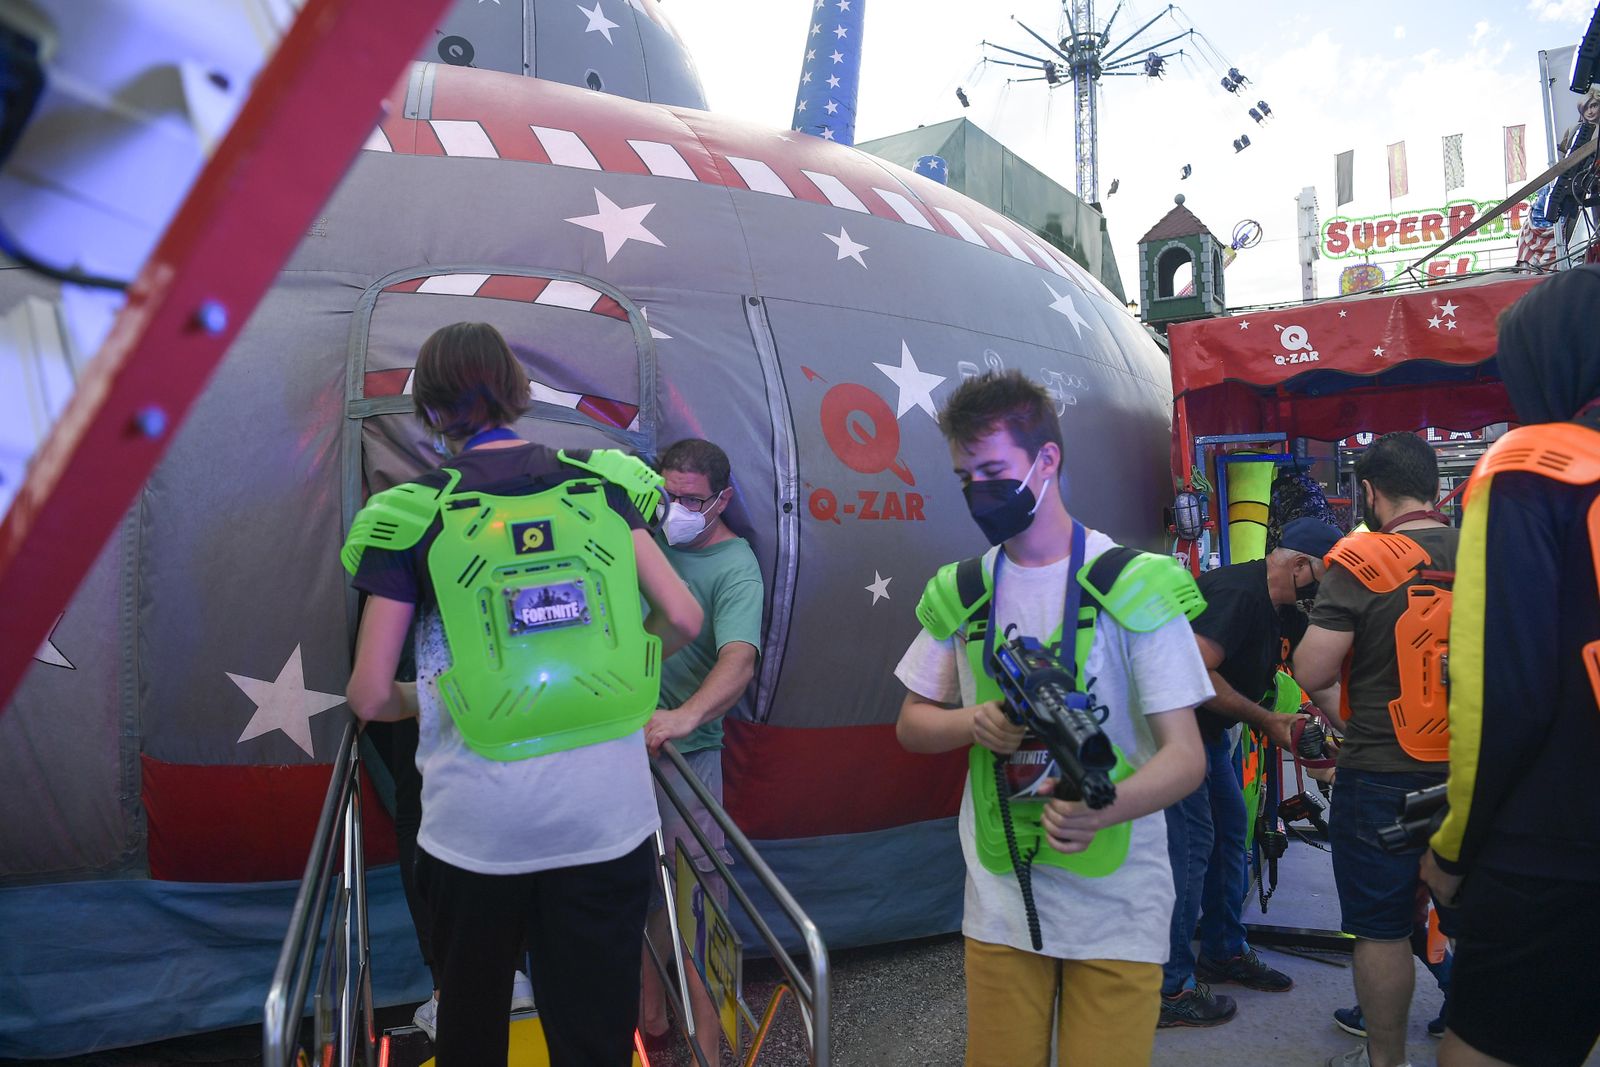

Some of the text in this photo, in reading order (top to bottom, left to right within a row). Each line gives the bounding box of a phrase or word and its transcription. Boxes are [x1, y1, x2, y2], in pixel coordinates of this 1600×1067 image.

[1273, 351, 1320, 366] Q-ZAR
[807, 487, 926, 525] Q-ZAR
[522, 601, 580, 625] FORTNITE
